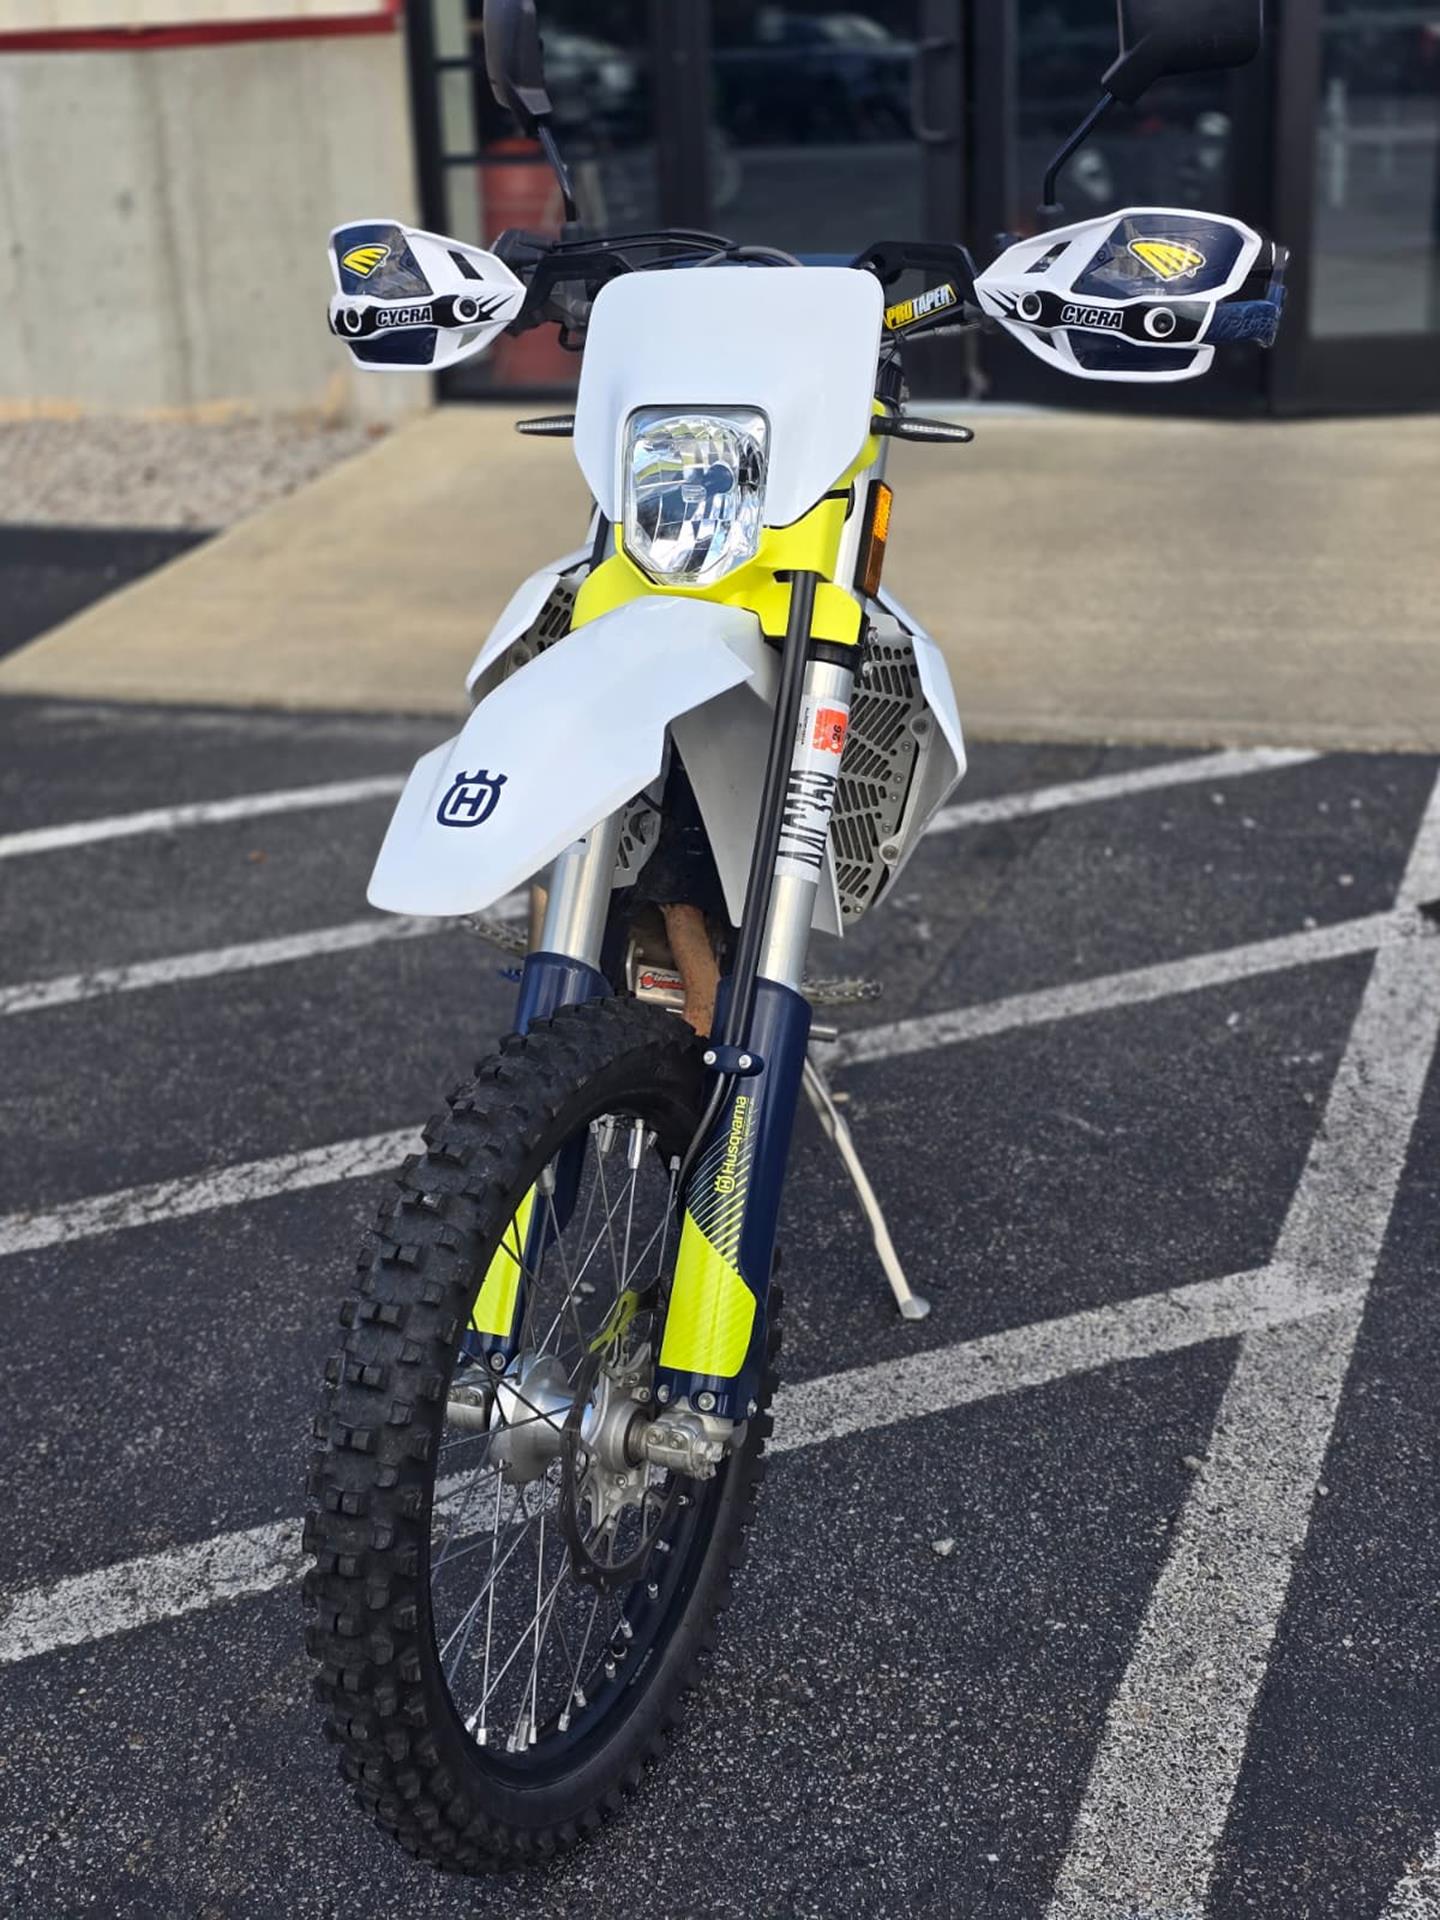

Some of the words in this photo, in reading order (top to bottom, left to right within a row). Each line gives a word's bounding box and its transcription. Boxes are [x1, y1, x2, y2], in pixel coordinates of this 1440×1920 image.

[376, 305, 433, 327] CYCRA
[1061, 304, 1124, 329] CYCRA
[831, 723, 842, 743] 26
[721, 1095, 747, 1174] Husqvarna
